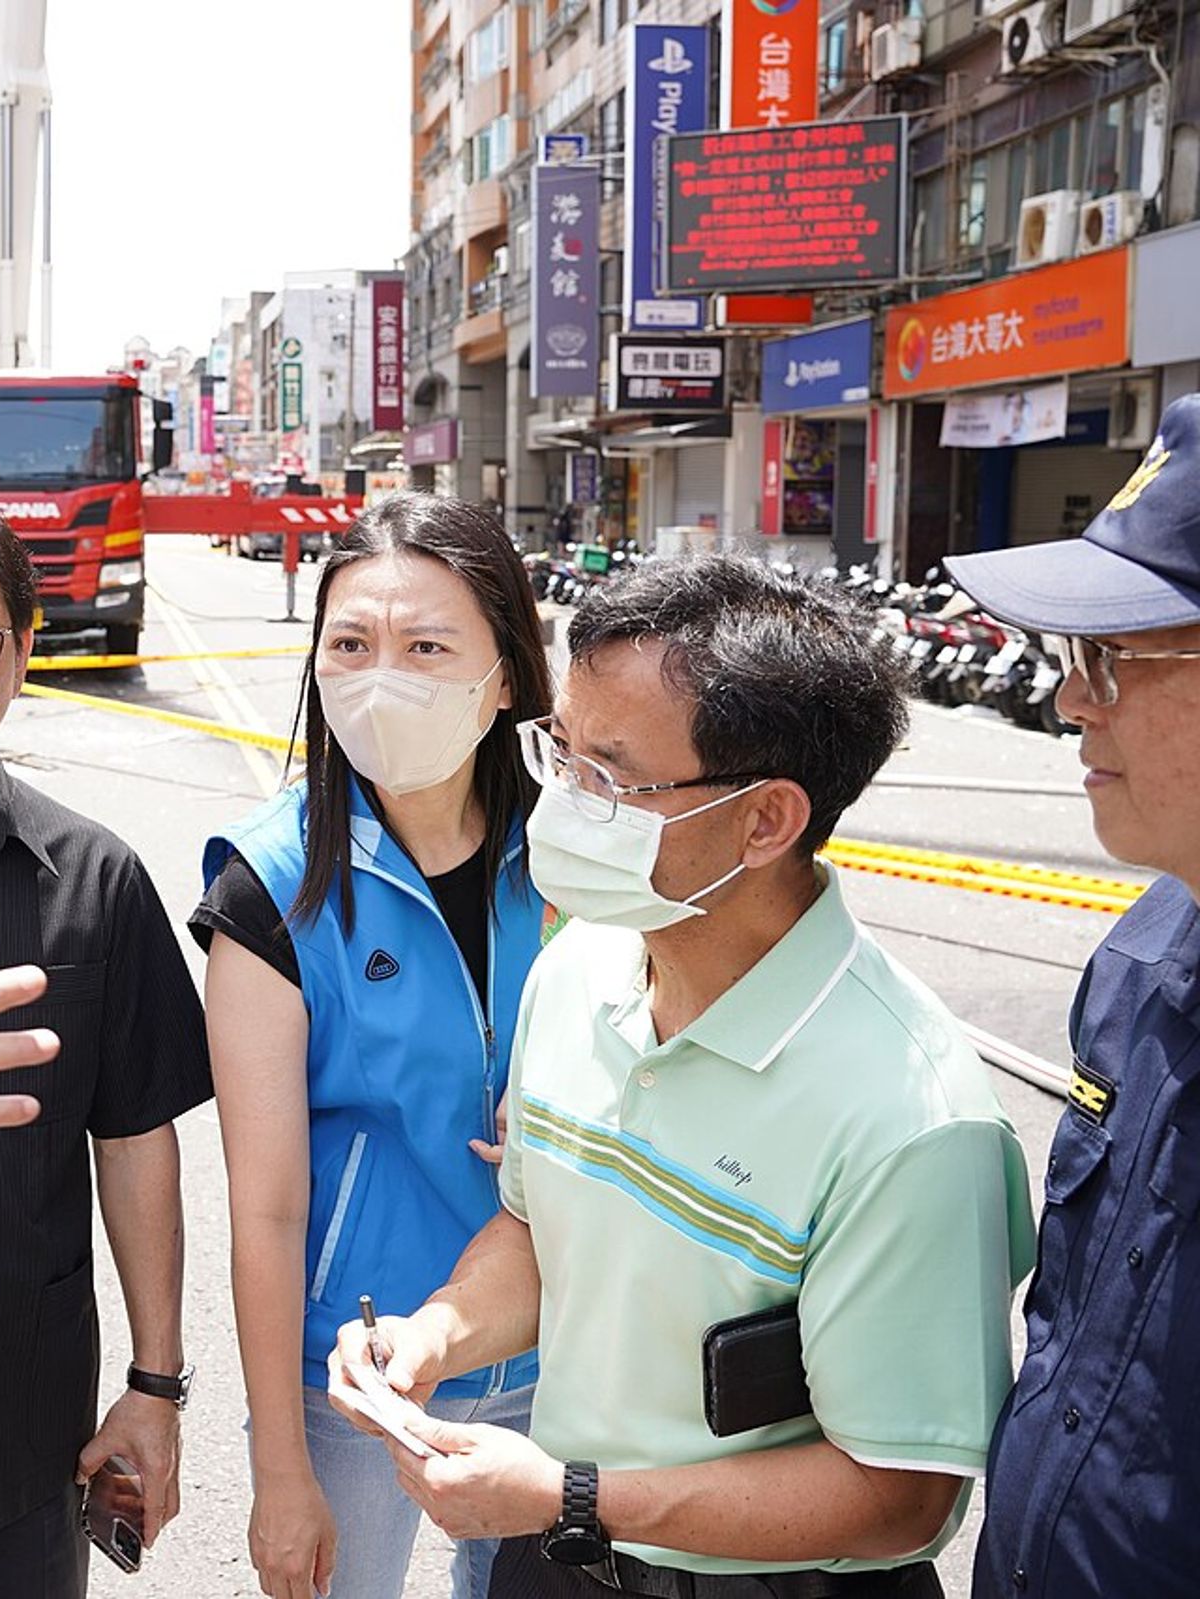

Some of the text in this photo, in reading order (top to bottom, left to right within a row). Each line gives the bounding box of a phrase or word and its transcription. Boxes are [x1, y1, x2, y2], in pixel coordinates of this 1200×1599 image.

[931, 309, 1025, 363] 台灣大哥大
[713, 1153, 752, 1188] hilltop
